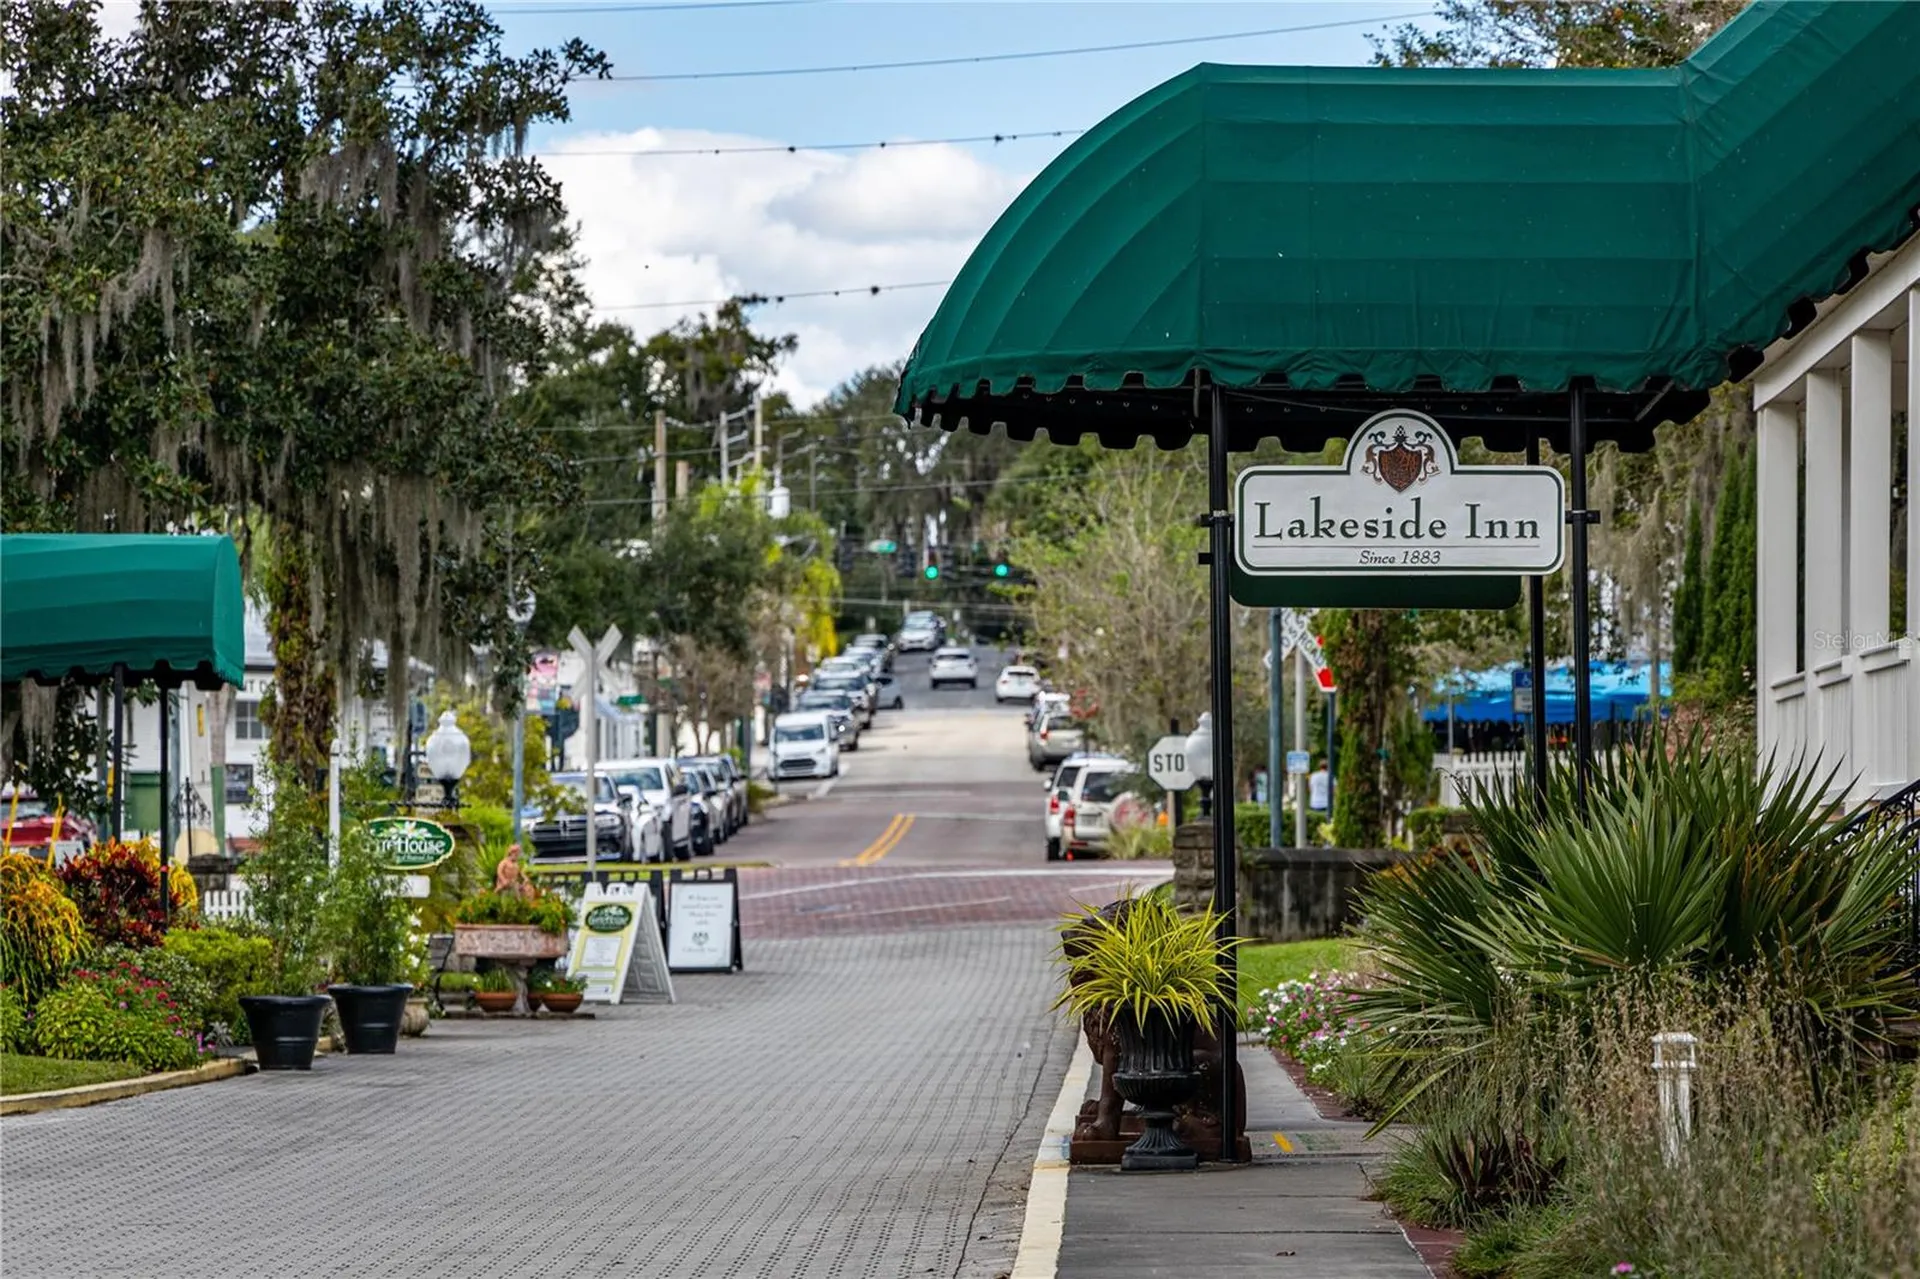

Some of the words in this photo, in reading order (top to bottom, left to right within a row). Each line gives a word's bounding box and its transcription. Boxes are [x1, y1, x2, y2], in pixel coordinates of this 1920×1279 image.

[1254, 496, 1448, 541] Lakeside
[1464, 503, 1540, 539] Inn
[1358, 550, 1397, 565] Since
[1400, 550, 1441, 565] 1883
[1153, 754, 1185, 773] STO
